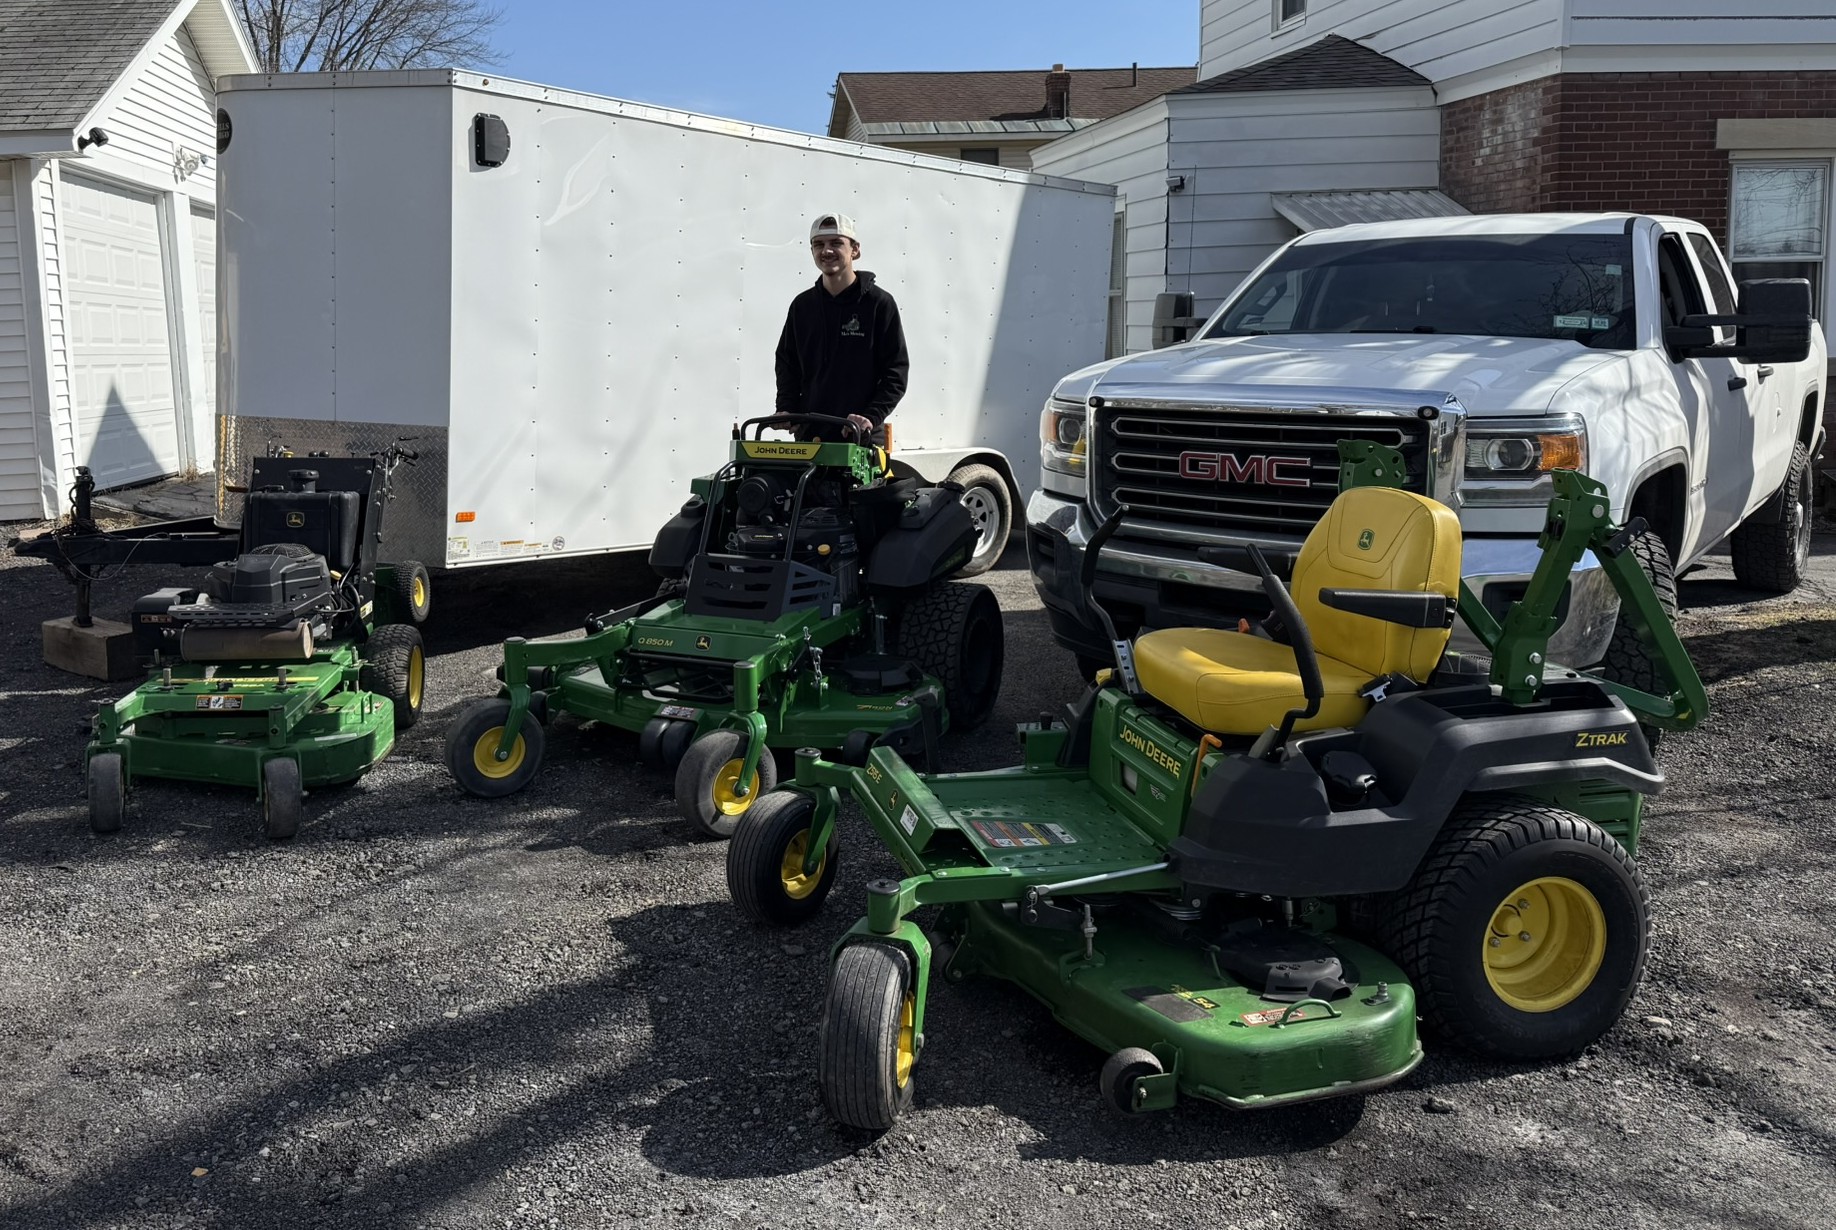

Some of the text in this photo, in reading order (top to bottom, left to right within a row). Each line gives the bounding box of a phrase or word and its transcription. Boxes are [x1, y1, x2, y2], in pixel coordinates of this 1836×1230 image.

[754, 446, 808, 455] JOHN DEERE
[1178, 450, 1311, 488] GMC
[1119, 724, 1182, 779] JOHN DEERE
[1575, 732, 1628, 748] ZTRAK
